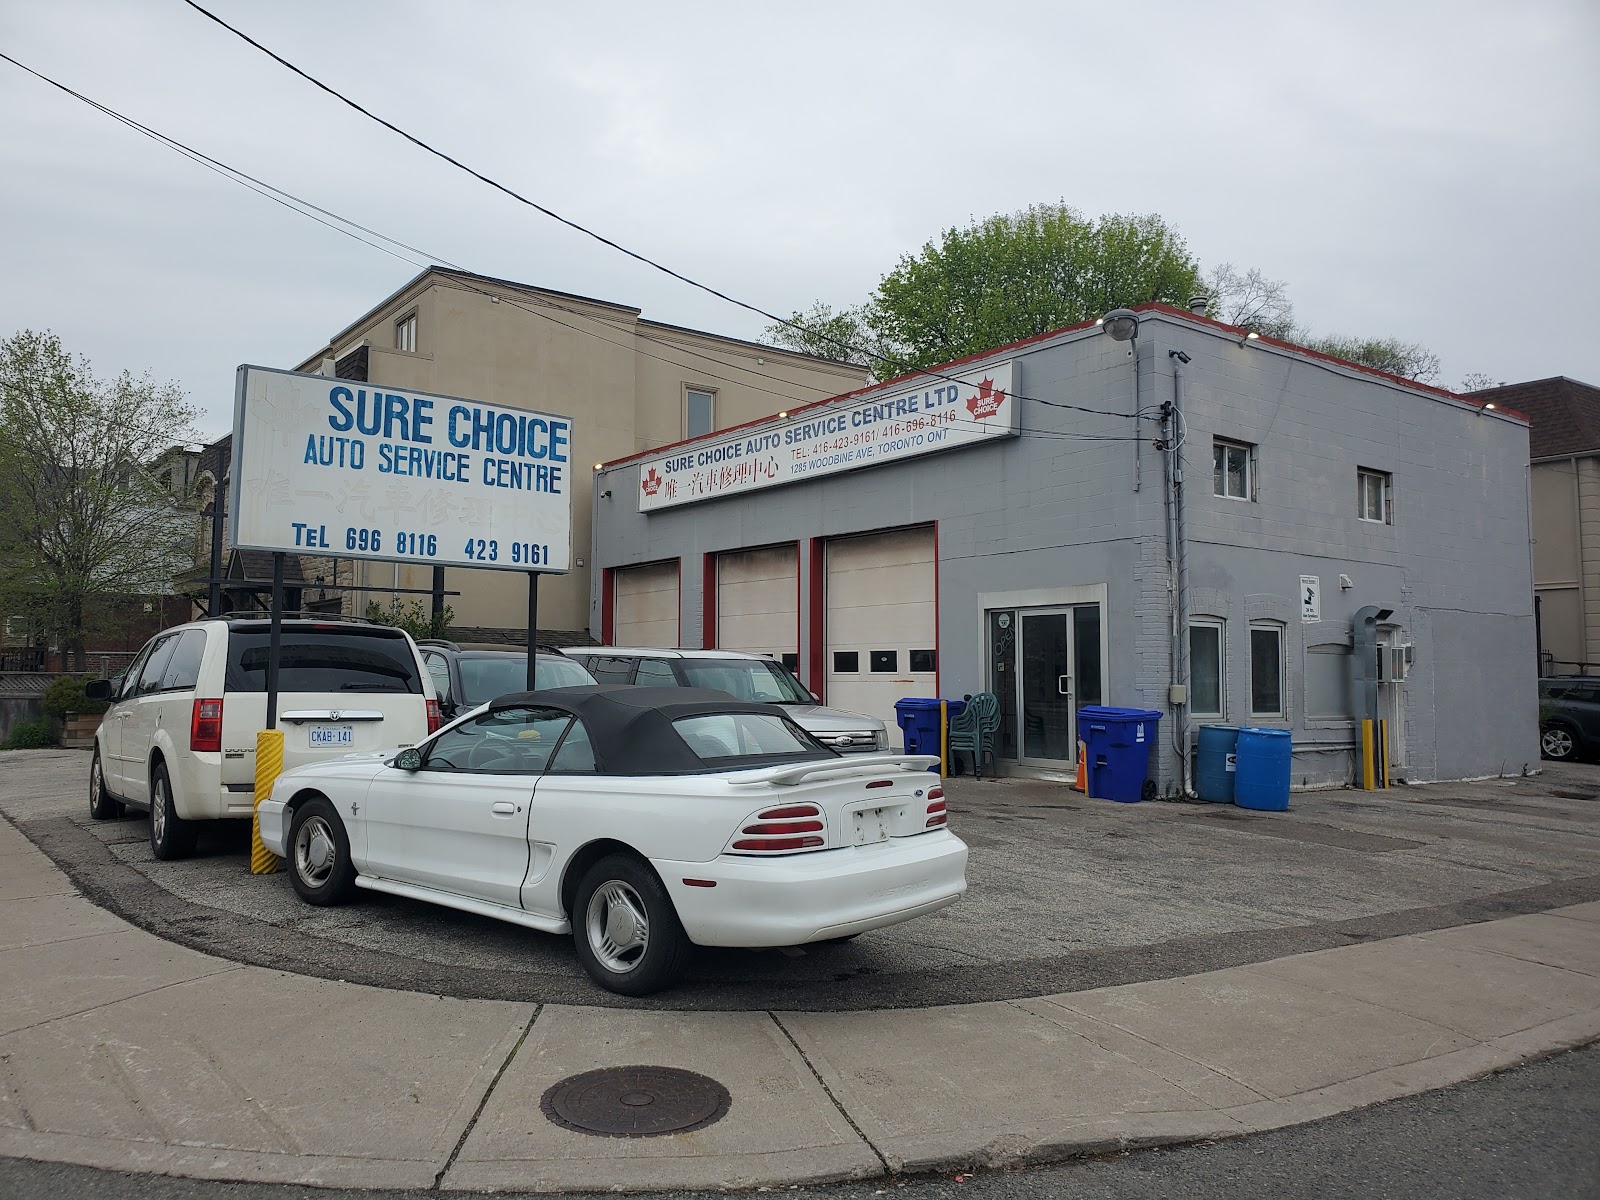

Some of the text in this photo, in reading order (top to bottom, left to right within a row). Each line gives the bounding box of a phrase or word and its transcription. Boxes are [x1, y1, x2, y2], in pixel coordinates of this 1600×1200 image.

[328, 386, 568, 463] SURE CHOICE
[973, 402, 998, 416] CHOICE
[977, 396, 995, 407] SURE
[665, 384, 959, 474] SURE CHOICE AUTO SERVICE CENTRE LTD
[790, 447, 810, 461] TEL:
[882, 409, 956, 439] 416-696-8116
[790, 428, 949, 474] 1285 WOODBINE AVE, TORONTO ONT
[303, 434, 562, 494] AUTO SERVICE CENTRE
[664, 455, 779, 500] 唯一汽車修理中心
[346, 527, 381, 552] 696
[397, 531, 437, 556] 8116
[464, 538, 498, 561] 423
[512, 542, 548, 565] 9161
